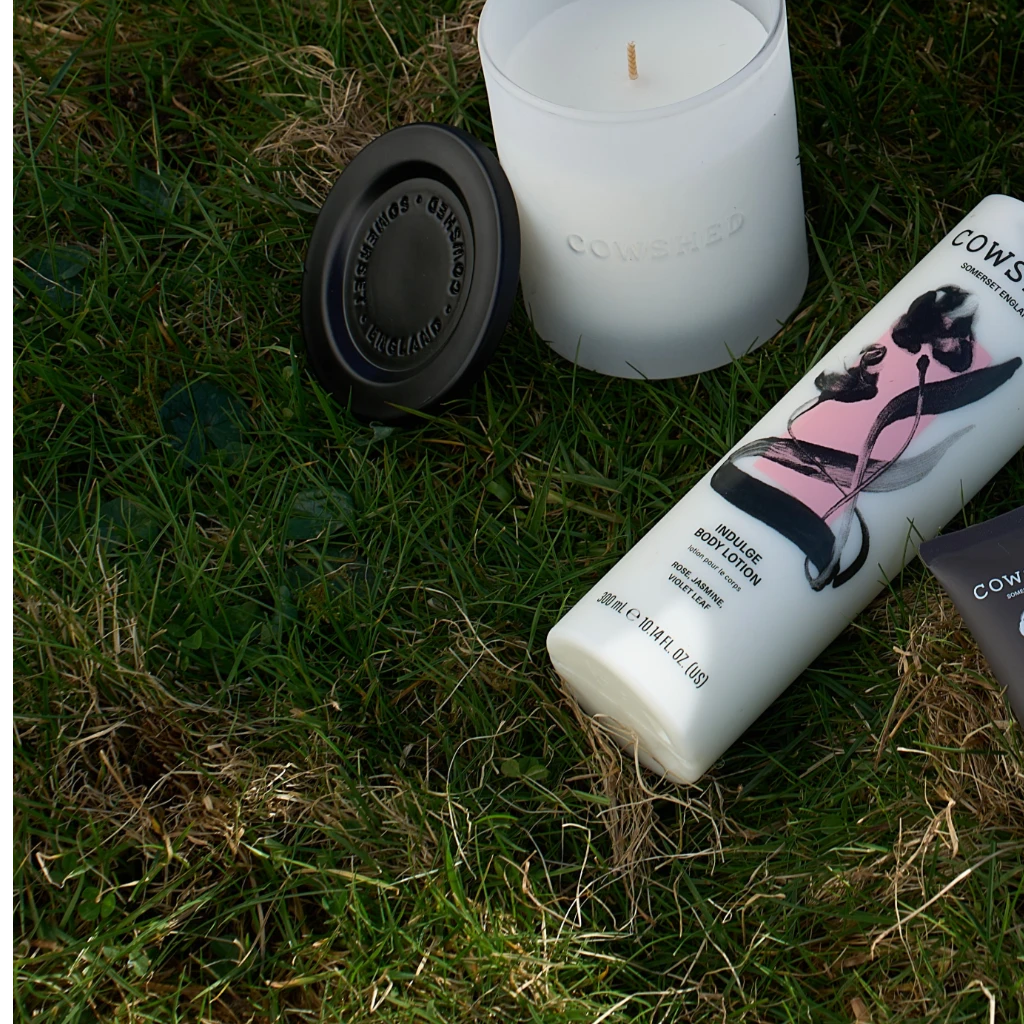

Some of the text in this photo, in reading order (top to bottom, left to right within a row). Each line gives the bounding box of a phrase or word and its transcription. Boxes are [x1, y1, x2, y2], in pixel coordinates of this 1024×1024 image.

[426, 195, 465, 295] COWSHED
[566, 213, 745, 261] COWSHED
[960, 262, 1001, 292] SOMERSET
[688, 544, 742, 592] lotion pour le corps
[694, 527, 762, 587] BODY LOTION
[715, 523, 763, 565] INDULGE
[668, 573, 711, 611] VIOLET LEAF
[671, 561, 725, 609] ROSE, JASMINE,
[597, 591, 616, 606] 300
[638, 616, 665, 642] 10.14
[659, 635, 674, 654] FL.
[672, 648, 690, 669] OZ.
[684, 662, 709, 689] (US)
